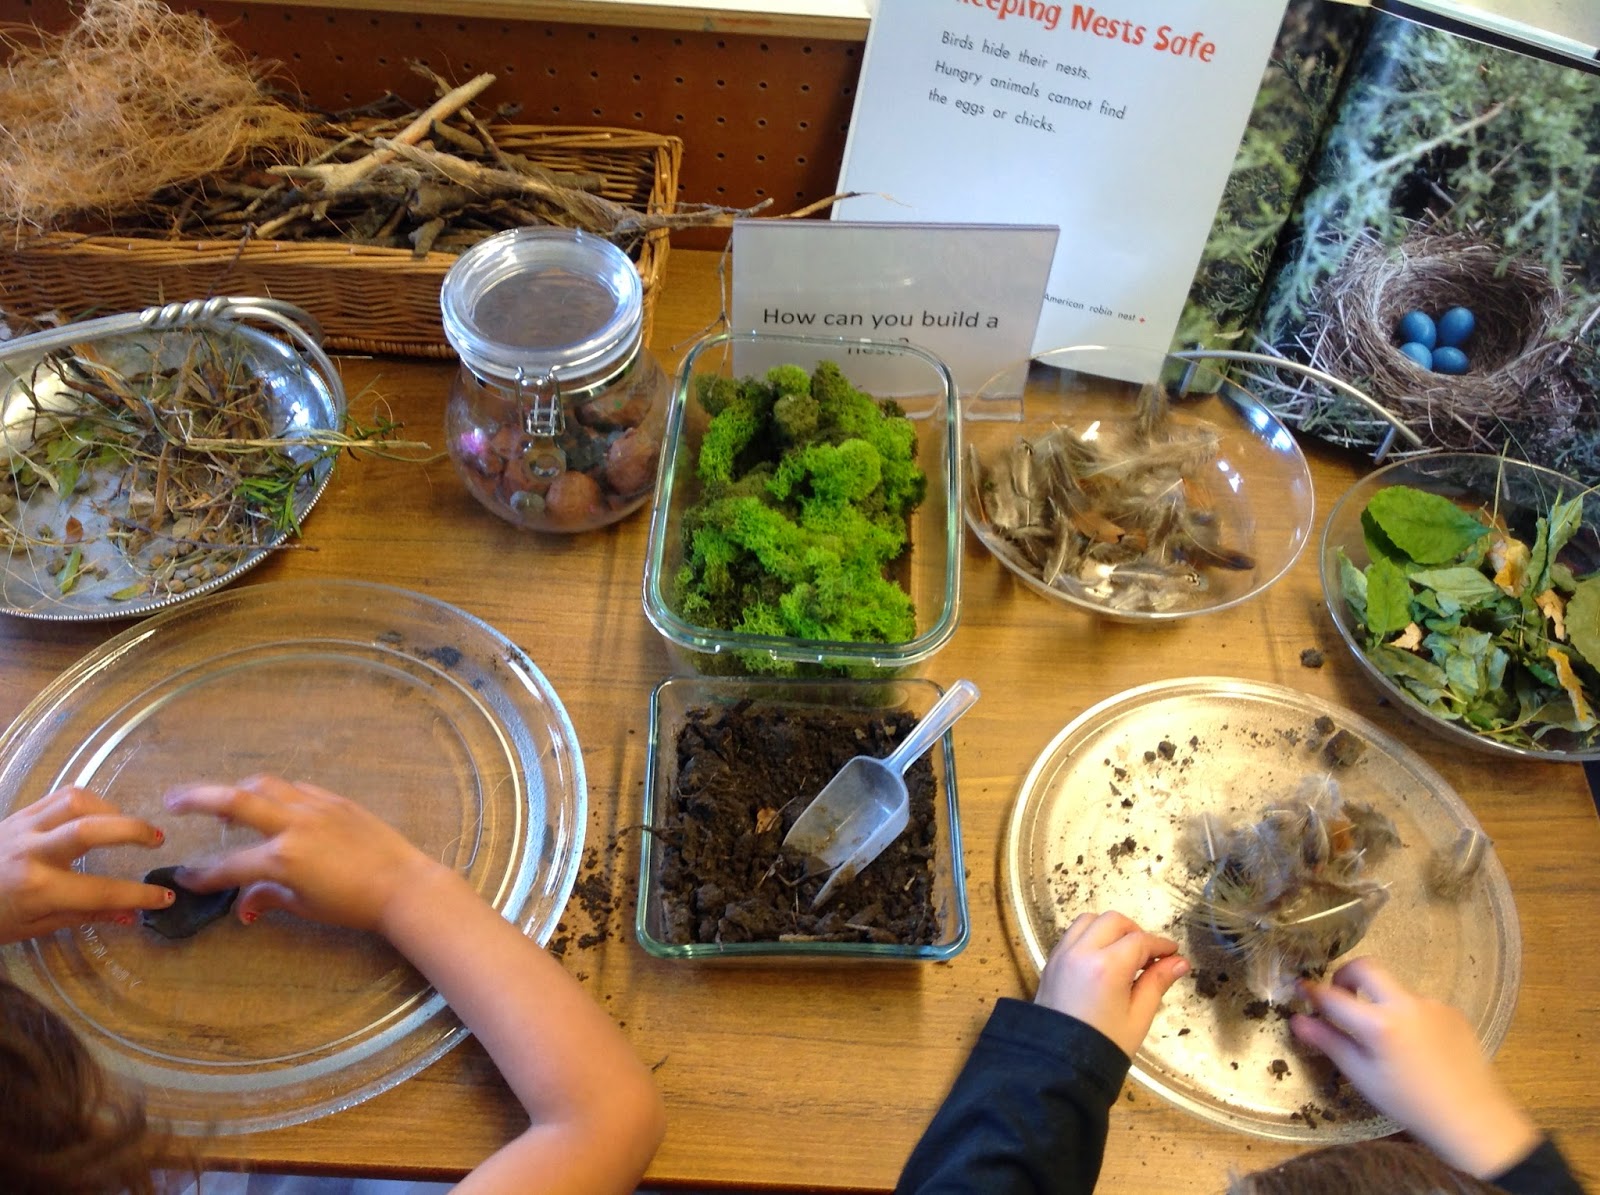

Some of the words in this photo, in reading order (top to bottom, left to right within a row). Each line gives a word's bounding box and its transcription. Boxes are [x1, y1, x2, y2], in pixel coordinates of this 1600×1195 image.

[956, 0, 1062, 30] eping
[1071, 5, 1147, 46] Nests
[1153, 25, 1216, 62] Safe
[941, 30, 974, 51] Birds
[982, 38, 1010, 60] hide
[1018, 49, 1048, 68] their
[1055, 61, 1090, 80] nests.
[928, 88, 947, 105] the
[955, 98, 985, 116] eggs
[993, 107, 1007, 119] or
[1014, 110, 1056, 133] chicks.
[935, 60, 982, 86] Hungry
[990, 76, 1040, 98] animals
[1047, 91, 1092, 111] cannot
[1100, 99, 1127, 120] find
[763, 308, 816, 325] How
[823, 312, 863, 327] can
[872, 313, 913, 330] you
[922, 310, 980, 329] build
[986, 316, 999, 329] a
[1044, 293, 1084, 310] American
[1089, 304, 1113, 316] robin
[1118, 311, 1136, 321] nest
